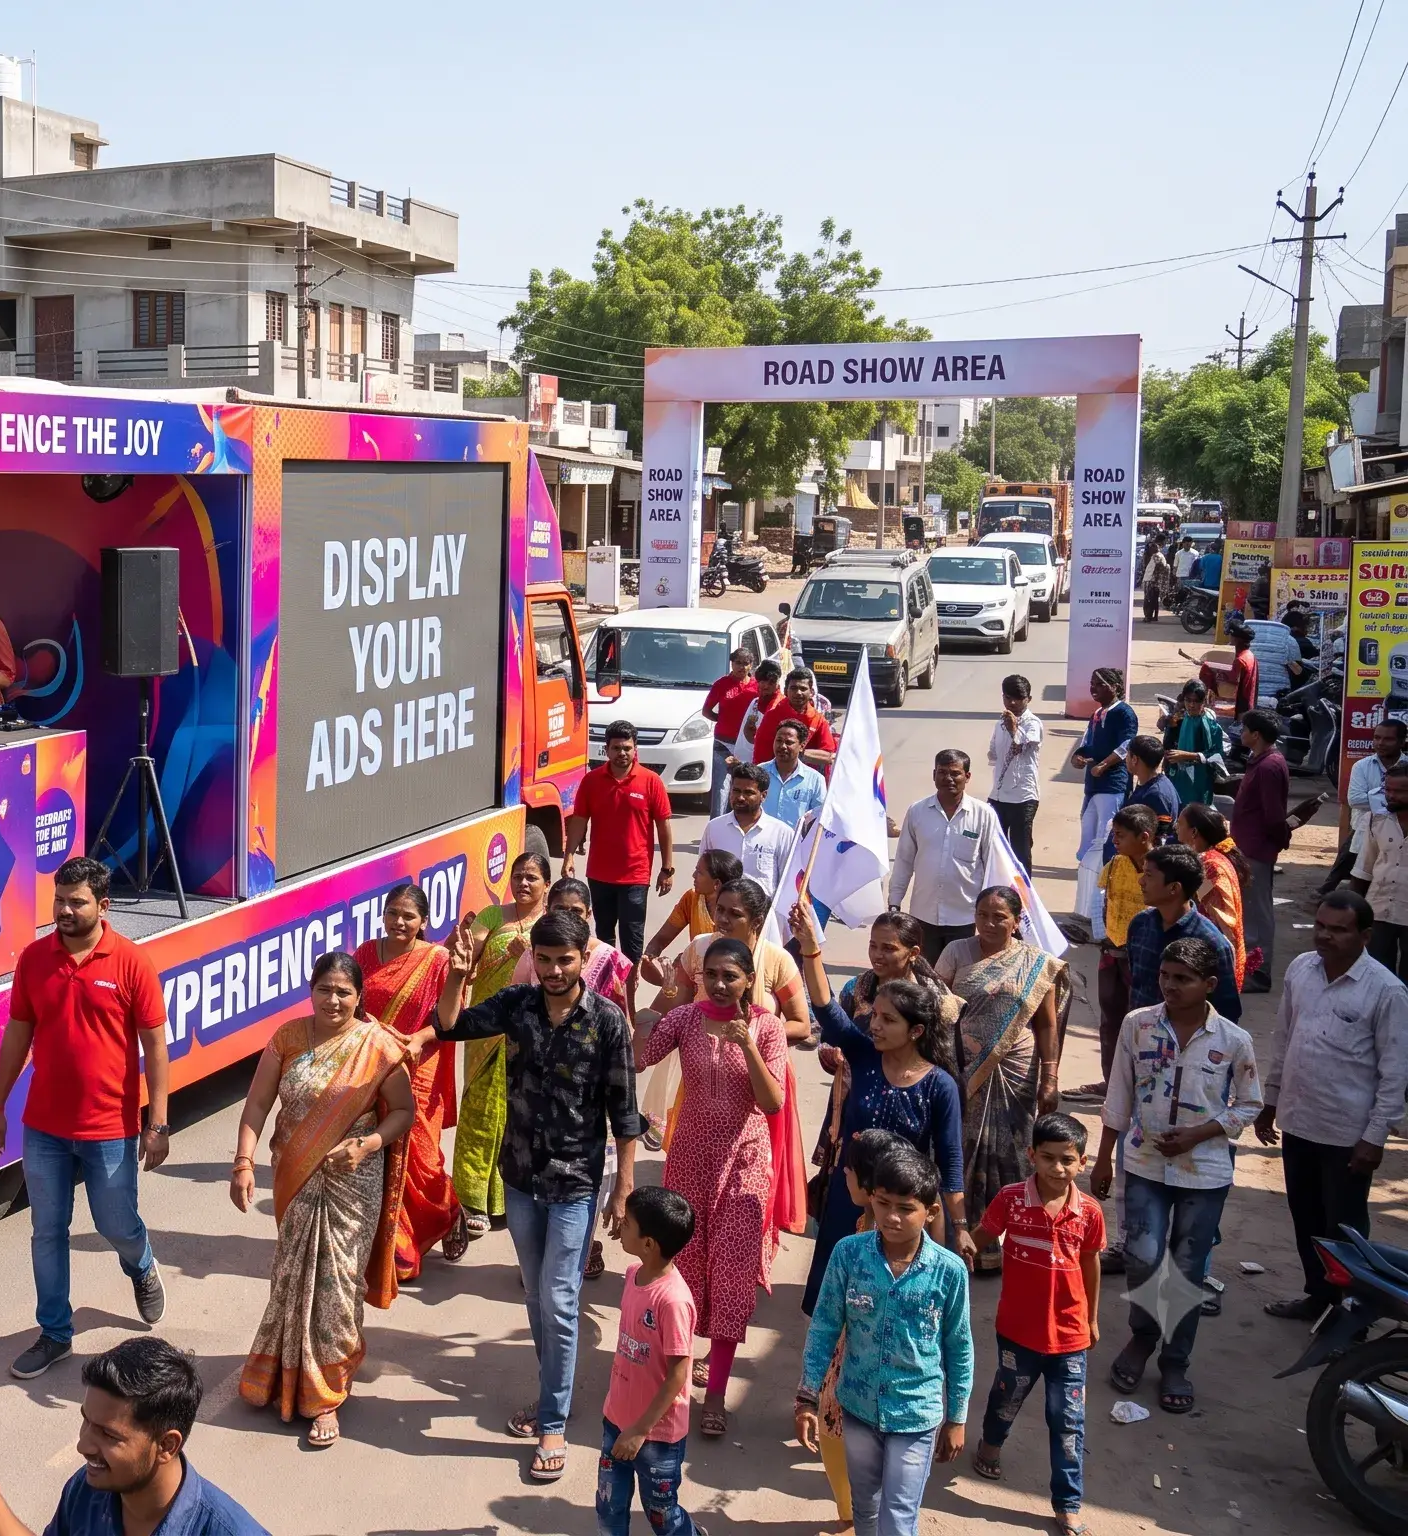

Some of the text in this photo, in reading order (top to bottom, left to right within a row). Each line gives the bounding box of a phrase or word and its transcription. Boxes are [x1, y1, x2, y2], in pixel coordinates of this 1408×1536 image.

[763, 354, 1006, 386] ROAD SHOW AREA
[72, 416, 117, 455] THE
[123, 418, 163, 456] JOY
[648, 468, 683, 482] ROAD
[1083, 468, 1125, 483] ROAD
[647, 488, 684, 502] SHOW
[1081, 490, 1126, 505] SHOW
[648, 508, 682, 522] AREA
[1082, 512, 1123, 528] AREA
[323, 533, 467, 611] DISPLAY
[348, 615, 442, 694] YOUR
[305, 686, 475, 792] ADS HERE
[139, 910, 344, 1057] XPERIENCE
[352, 892, 389, 949] TH
